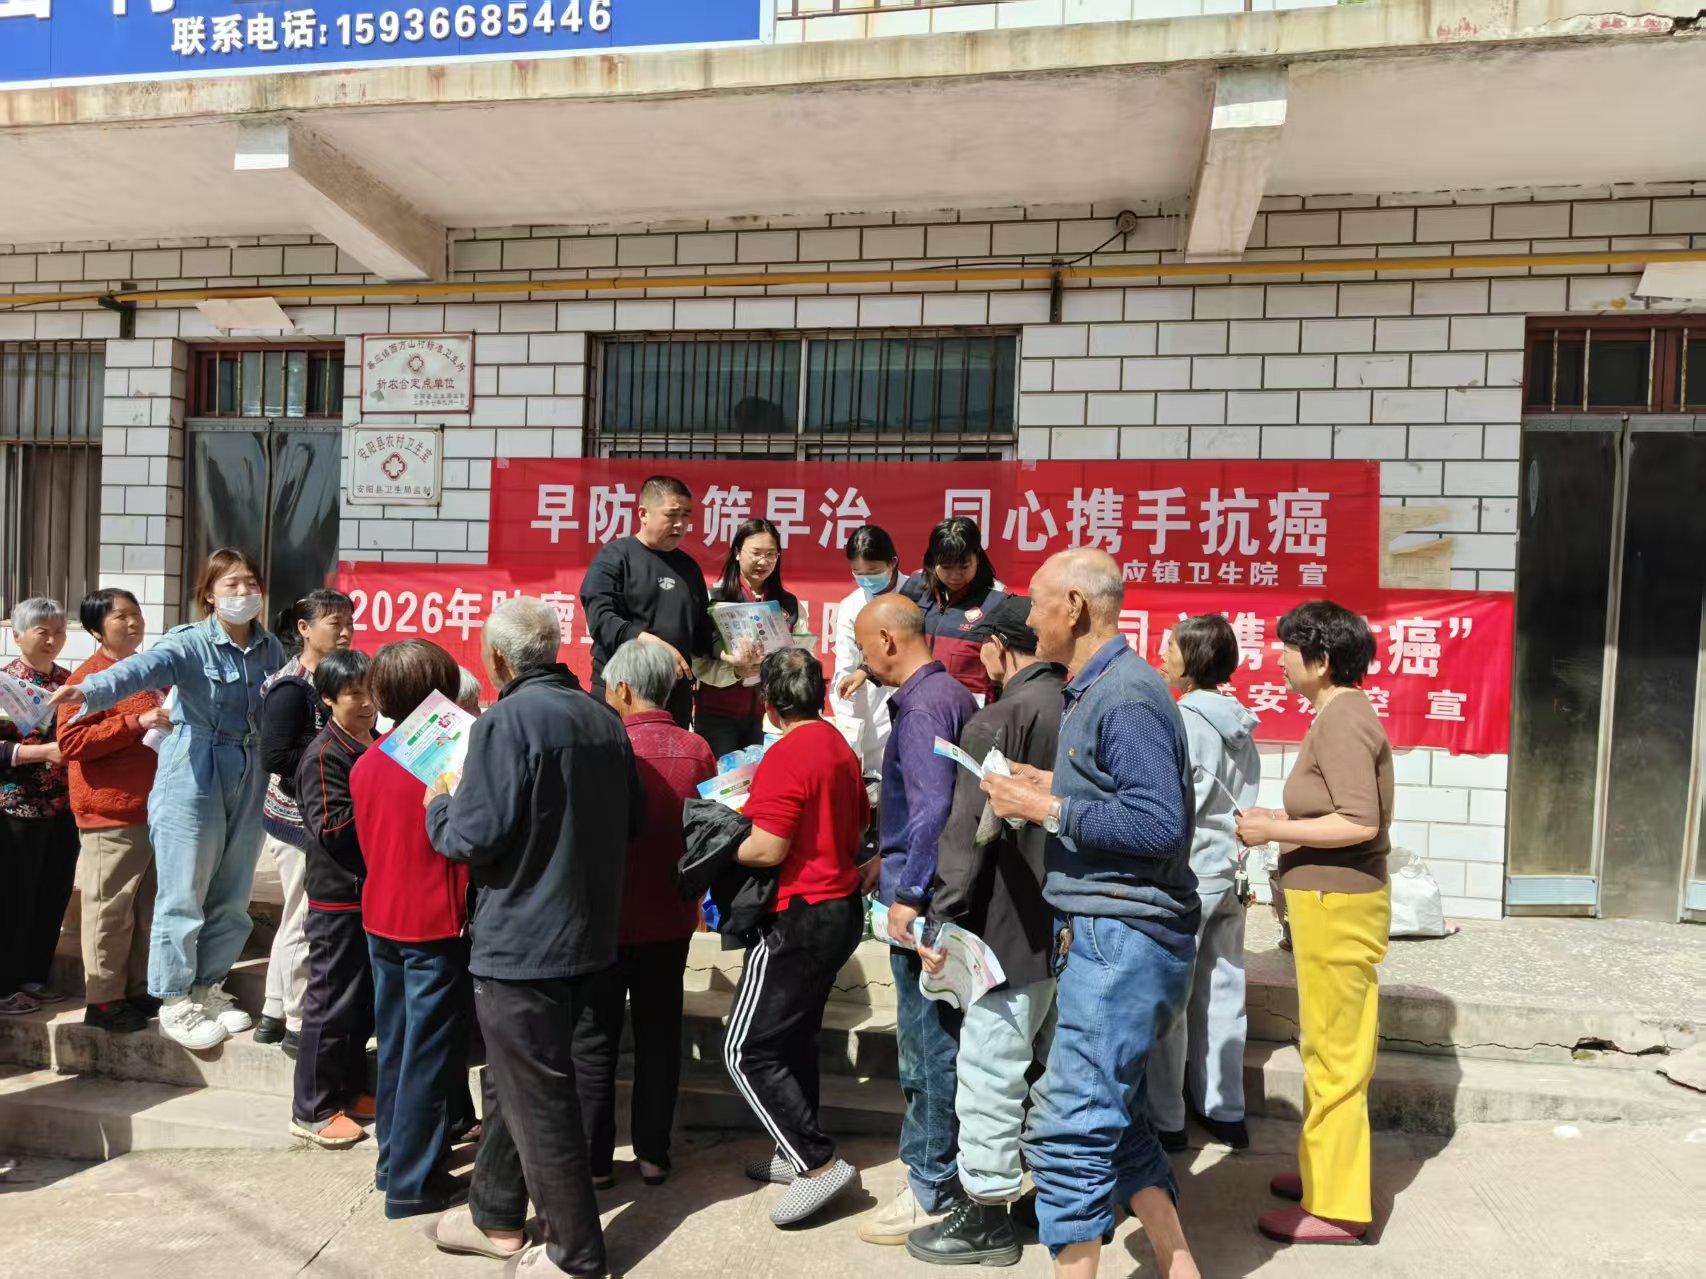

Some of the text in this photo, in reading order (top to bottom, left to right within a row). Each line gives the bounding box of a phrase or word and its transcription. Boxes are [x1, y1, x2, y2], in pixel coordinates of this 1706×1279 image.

[376, 377, 456, 390] 新农合定点单位
[357, 434, 433, 464] 安阳县农村卫生室
[356, 485, 432, 495] 安阳县卫生局监制
[530, 483, 872, 551] 早防筛早治
[1298, 562, 1328, 588] 宣
[1425, 689, 1468, 722] 宣
